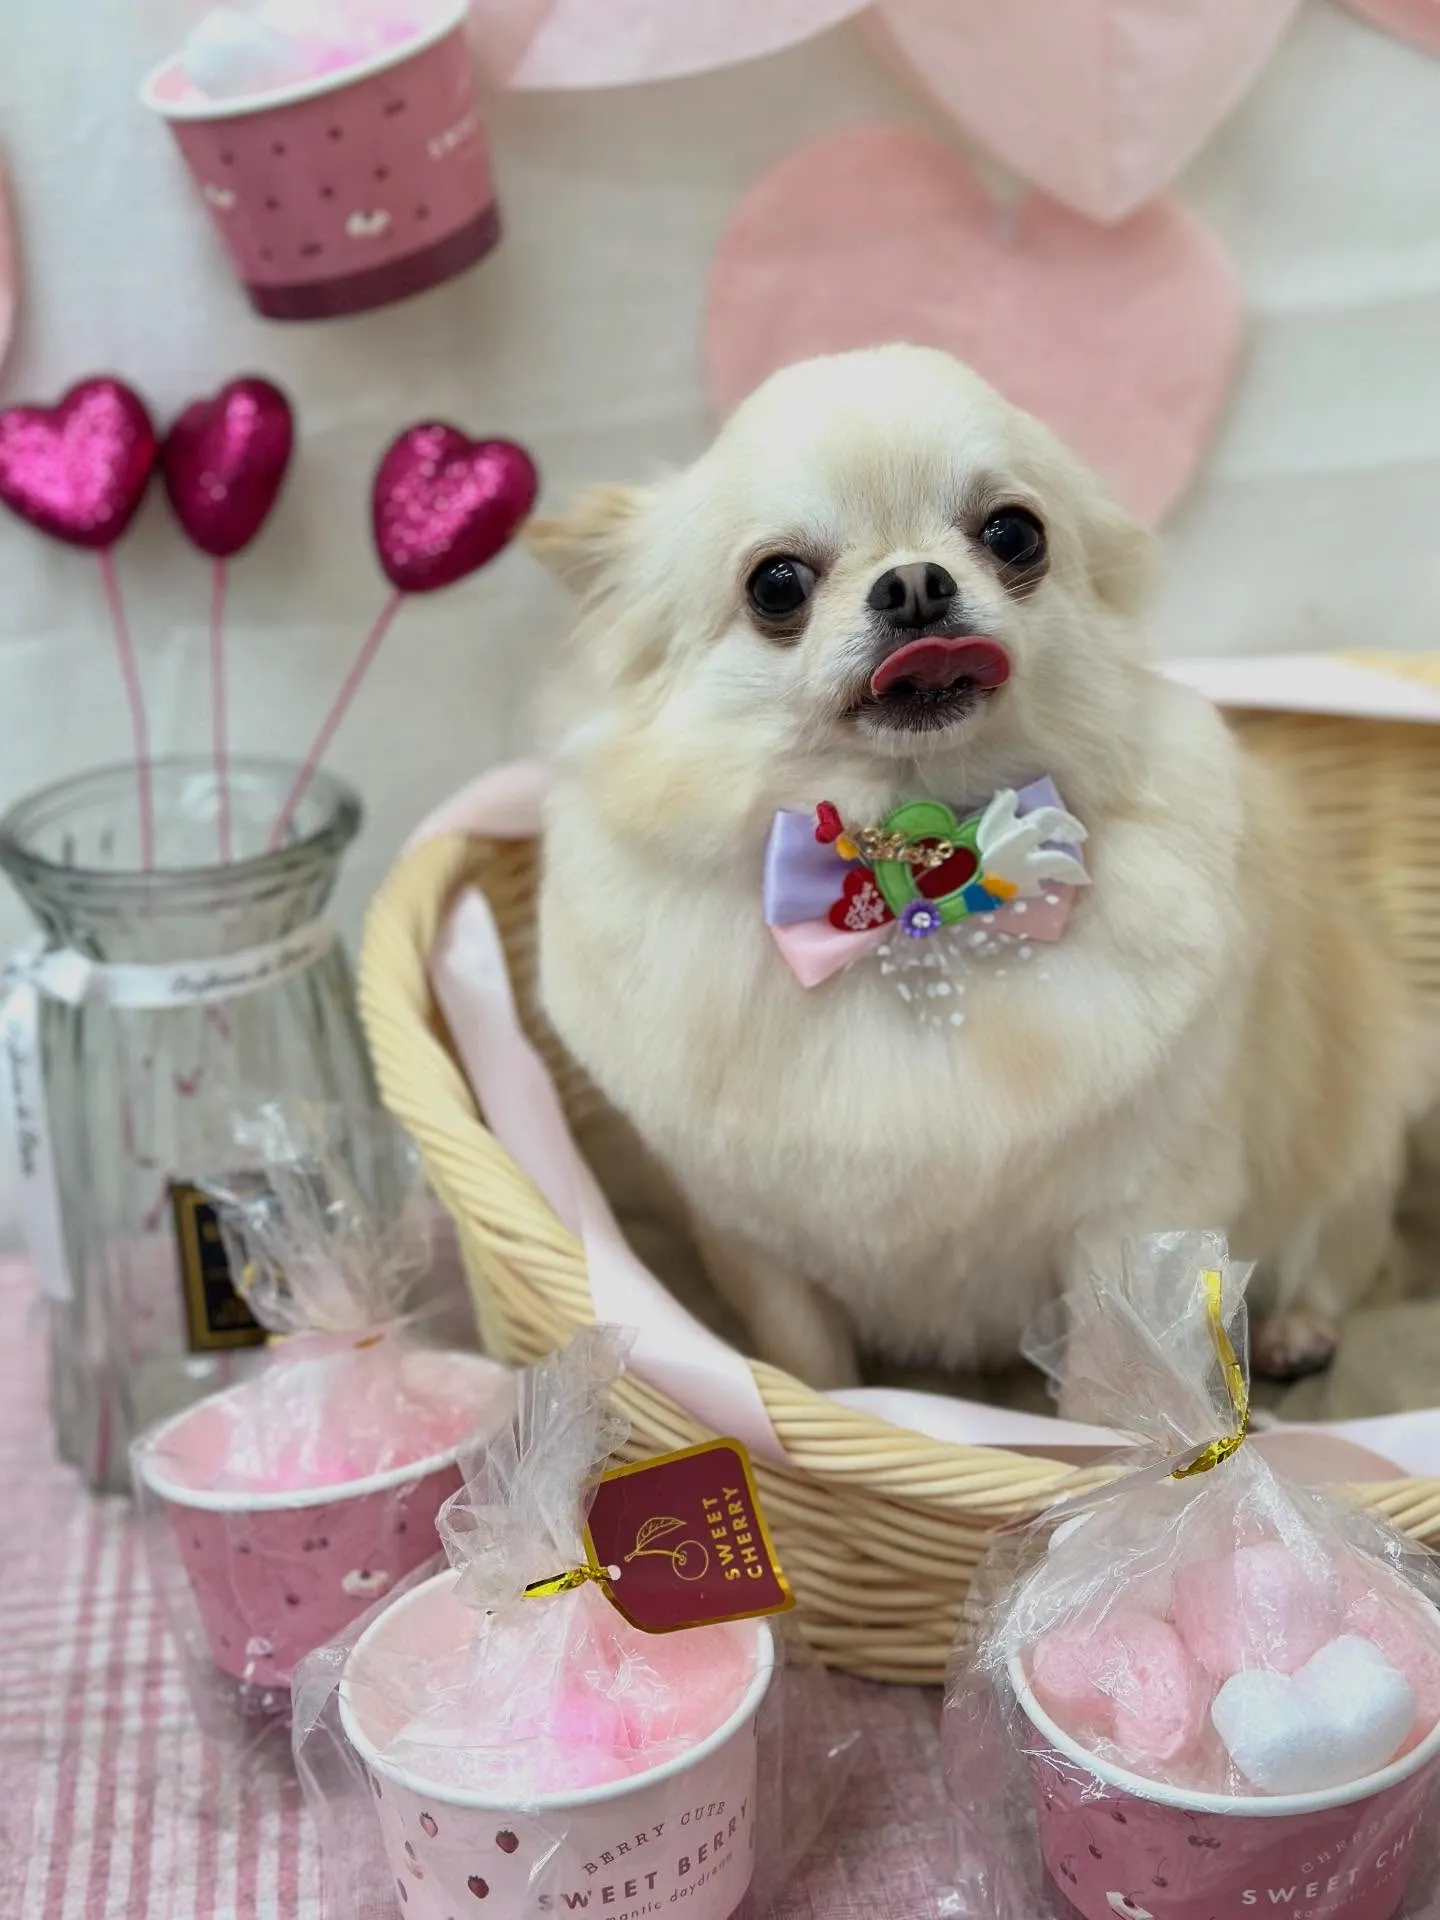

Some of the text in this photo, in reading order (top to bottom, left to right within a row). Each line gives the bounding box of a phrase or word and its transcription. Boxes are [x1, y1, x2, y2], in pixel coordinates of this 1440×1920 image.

[702, 1498, 741, 1580] SWEET
[722, 1487, 763, 1579] CHERRY
[537, 1796, 748, 1911] SWEET BERRY
[582, 1801, 725, 1876] BERRY CUTE
[1241, 1867, 1360, 1905] SWEET
